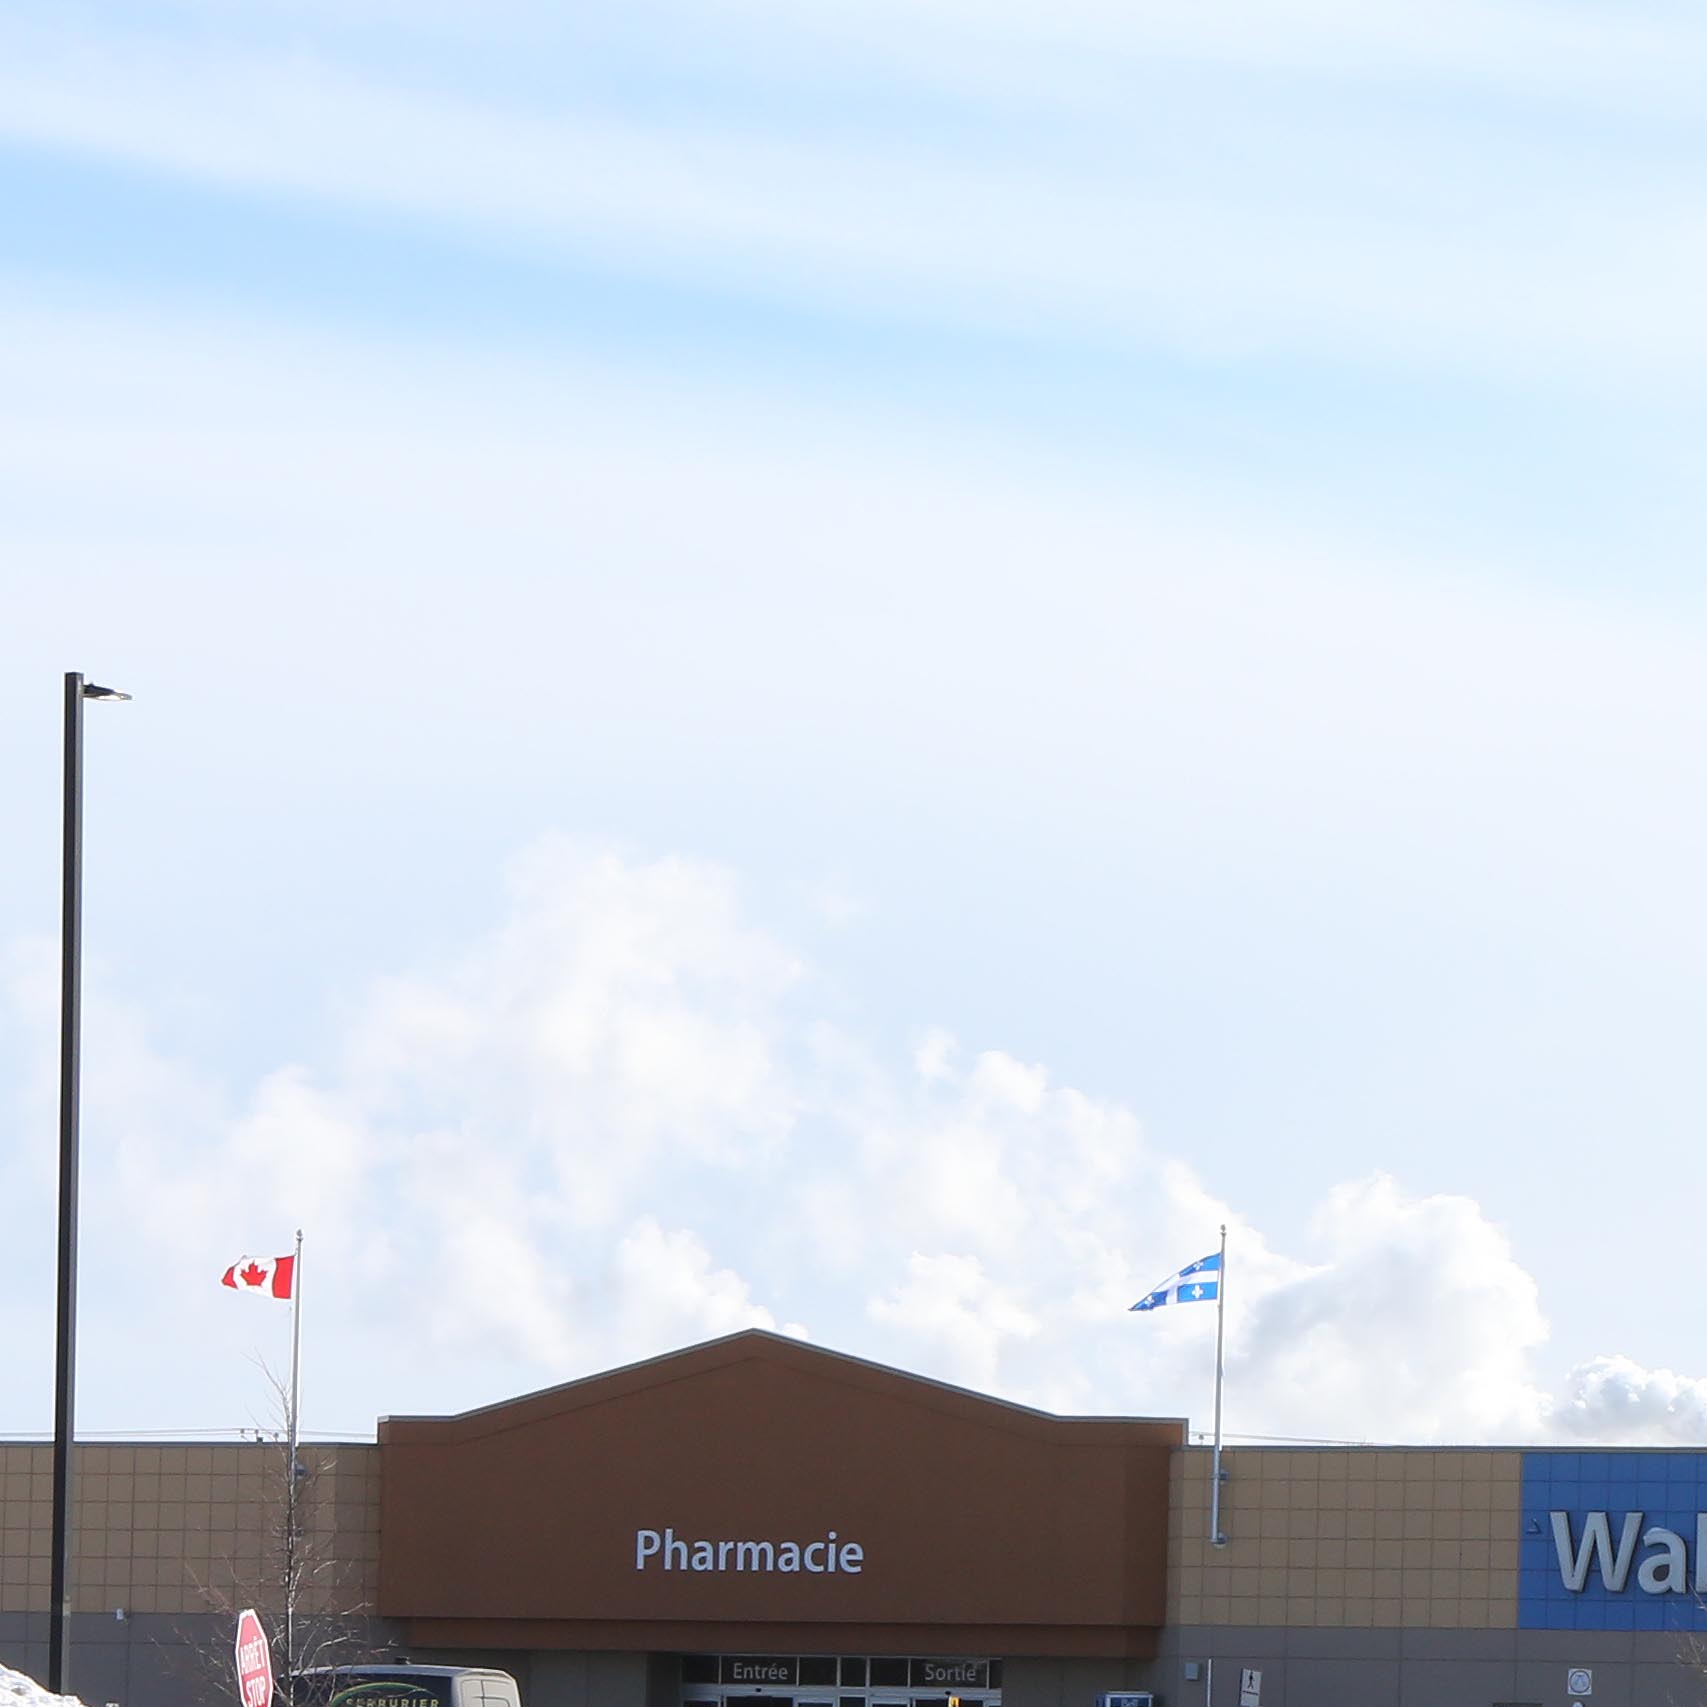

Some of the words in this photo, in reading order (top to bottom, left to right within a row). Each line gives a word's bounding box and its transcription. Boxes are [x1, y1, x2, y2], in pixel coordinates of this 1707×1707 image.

[635, 1528, 864, 1573] Pharmacie
[240, 1635, 265, 1675] ARRÊT
[733, 1662, 789, 1680] Entrée
[925, 1663, 976, 1680] Sortie
